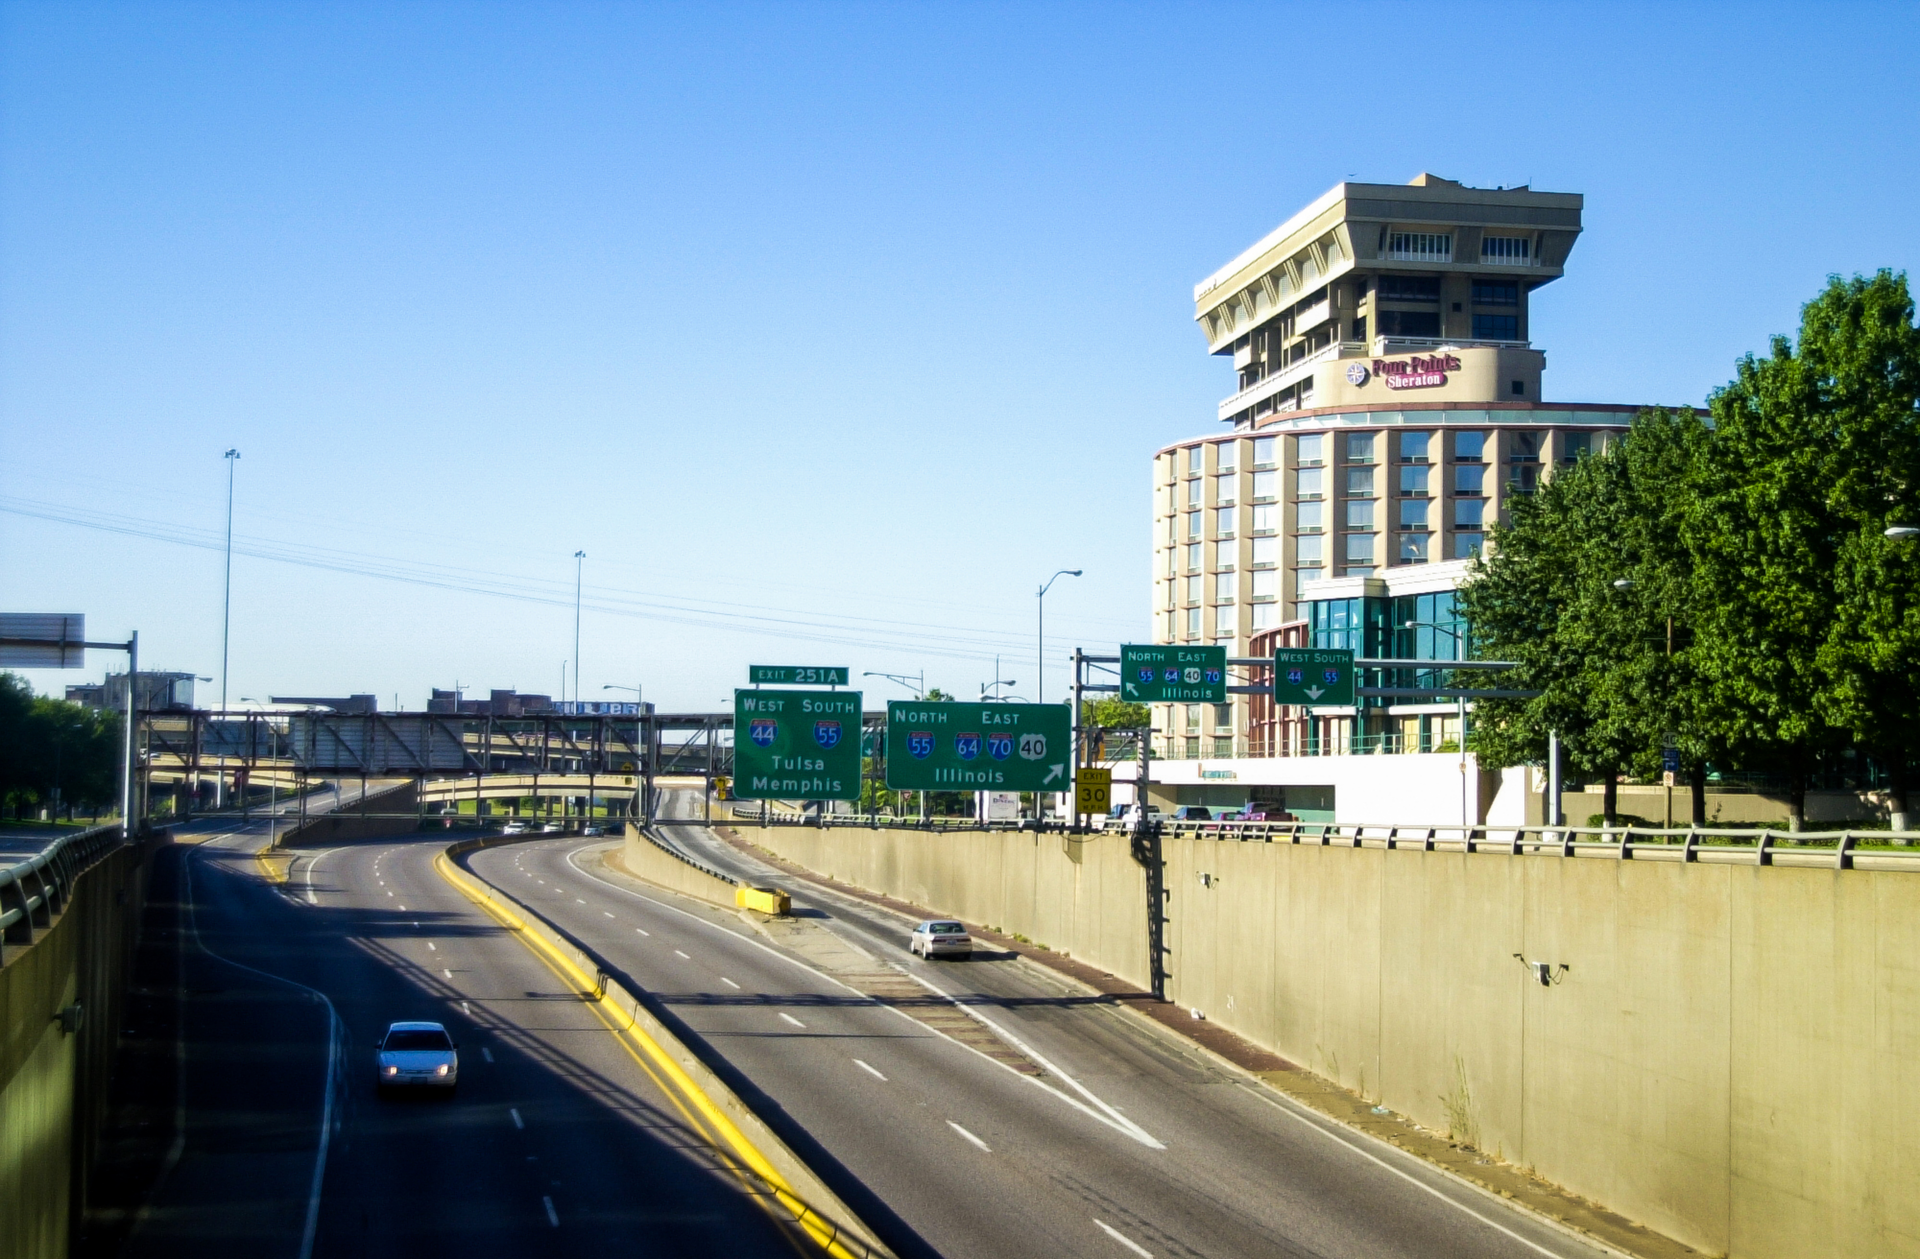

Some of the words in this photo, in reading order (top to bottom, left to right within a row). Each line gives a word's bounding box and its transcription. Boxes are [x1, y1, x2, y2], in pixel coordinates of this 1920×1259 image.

[1371, 359, 1408, 377] Four
[1410, 353, 1461, 373] Points
[1387, 374, 1441, 389] Sheraton
[1128, 651, 1165, 662] NORTH
[1178, 652, 1207, 662] EAST
[1280, 653, 1310, 663] WEST
[1313, 653, 1349, 664] SOUTH
[758, 669, 786, 680] EXIT
[795, 668, 839, 683] 251A
[1140, 671, 1153, 681] 55
[1164, 671, 1178, 681] 64
[1185, 670, 1200, 681] 40
[1205, 671, 1220, 682] 70
[1288, 672, 1301, 682] 44
[1325, 672, 1338, 683] 55
[1162, 687, 1213, 699] Illinois
[743, 698, 785, 712] WEST
[802, 699, 855, 714] SOUTH
[895, 709, 948, 724] NORTH
[982, 711, 1020, 725] EAST
[752, 726, 775, 743] 44
[819, 727, 838, 744] 55
[911, 738, 931, 755] 55
[957, 738, 979, 755] 64
[989, 739, 1012, 756] 70
[1021, 739, 1045, 756] 40
[772, 755, 825, 771] Tulsa
[935, 768, 1005, 783] Illinois
[1083, 772, 1104, 780] EXIT
[752, 776, 842, 794] Memphis
[1081, 788, 1106, 802] 30
